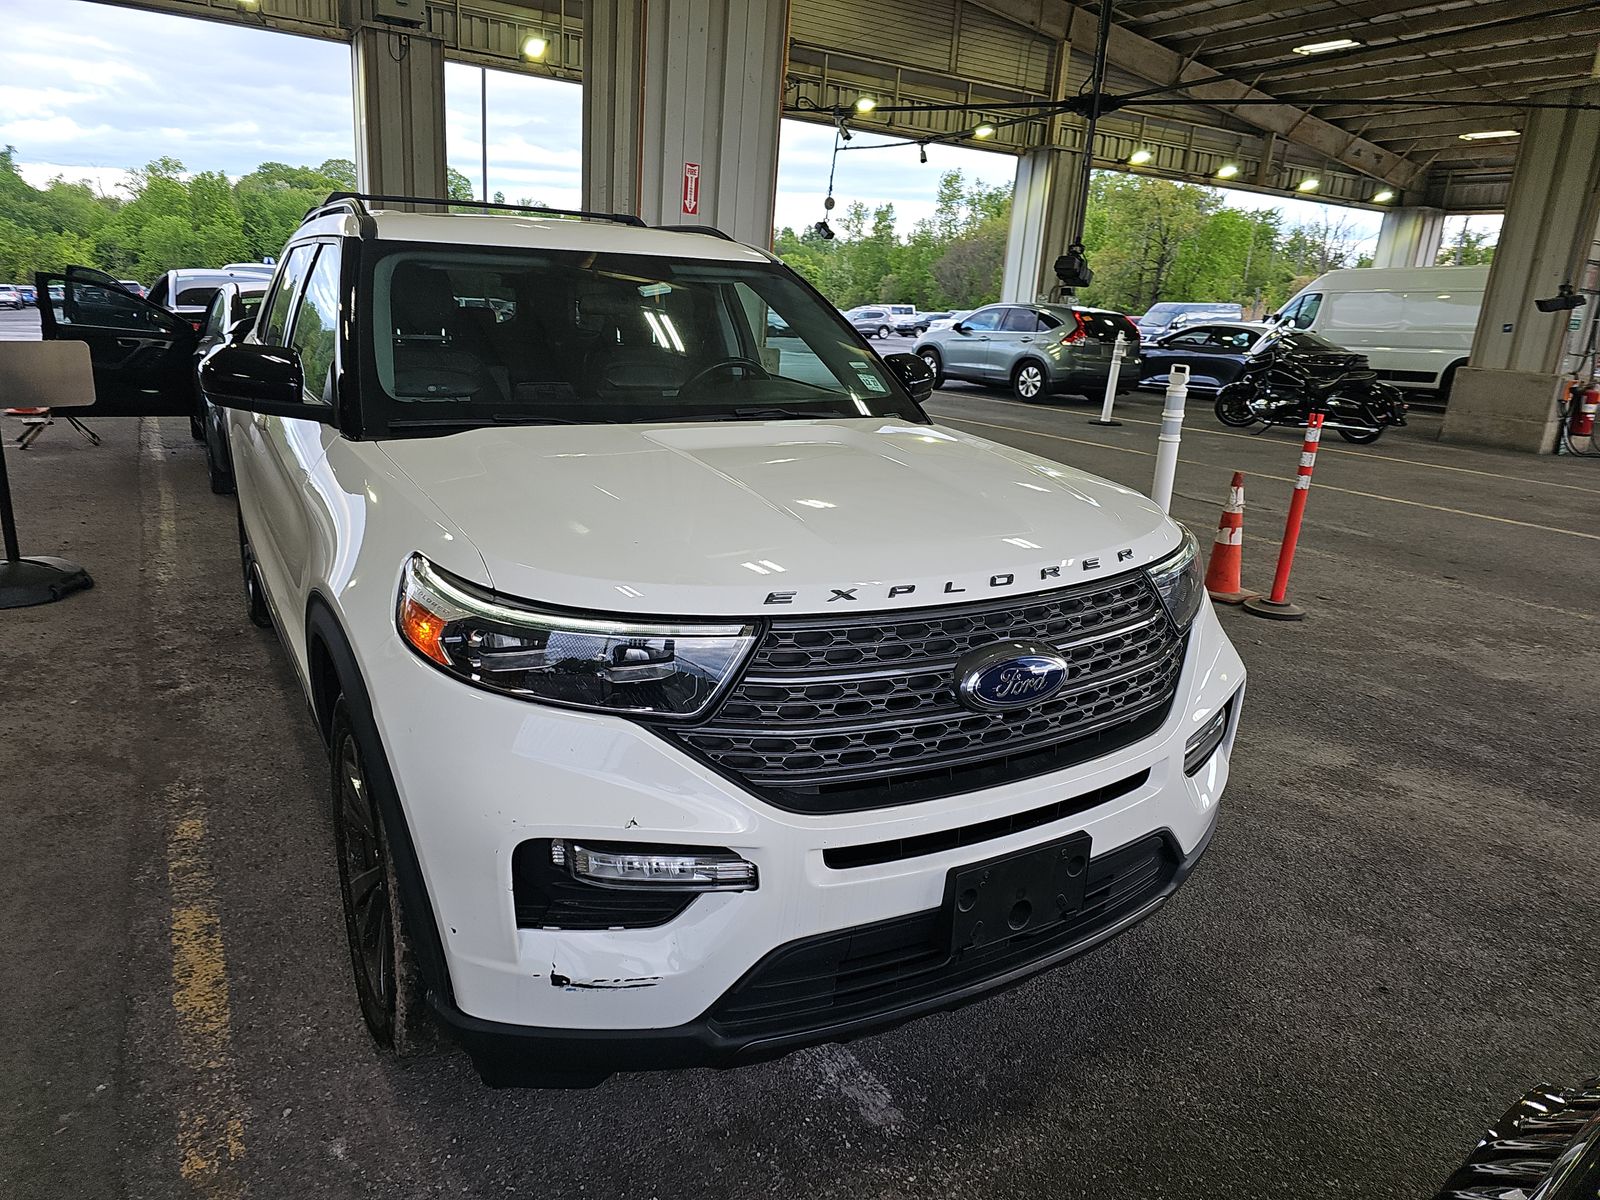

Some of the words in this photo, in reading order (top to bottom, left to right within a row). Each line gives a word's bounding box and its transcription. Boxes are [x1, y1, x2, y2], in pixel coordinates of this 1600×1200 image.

[764, 549, 1134, 605] EXPLORER
[414, 586, 450, 614] PLORER
[995, 667, 1049, 698] Ford
